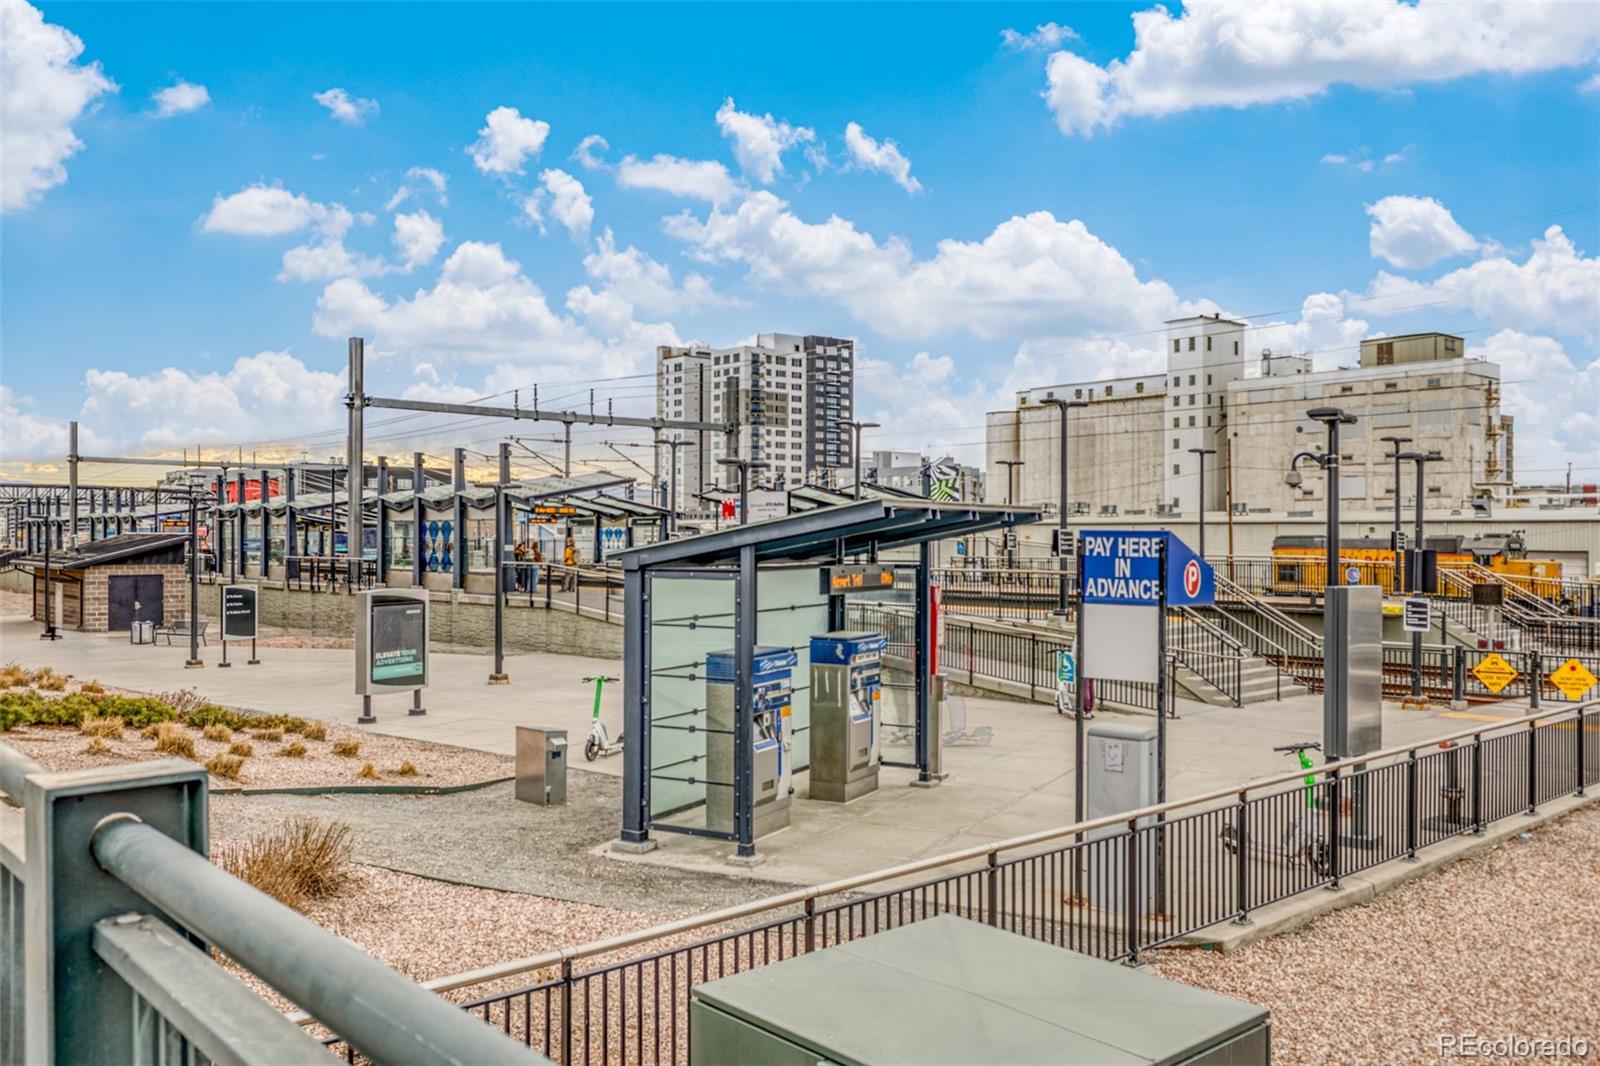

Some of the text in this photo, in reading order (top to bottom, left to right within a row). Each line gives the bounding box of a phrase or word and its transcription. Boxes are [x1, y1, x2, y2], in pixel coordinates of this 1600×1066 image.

[1085, 537, 1114, 556] PAY
[1117, 537, 1160, 558] HERE
[1115, 558, 1130, 578] IN
[1188, 565, 1198, 592] P
[1085, 578, 1160, 600] ADVANCE
[375, 651, 400, 659] ELEVATE
